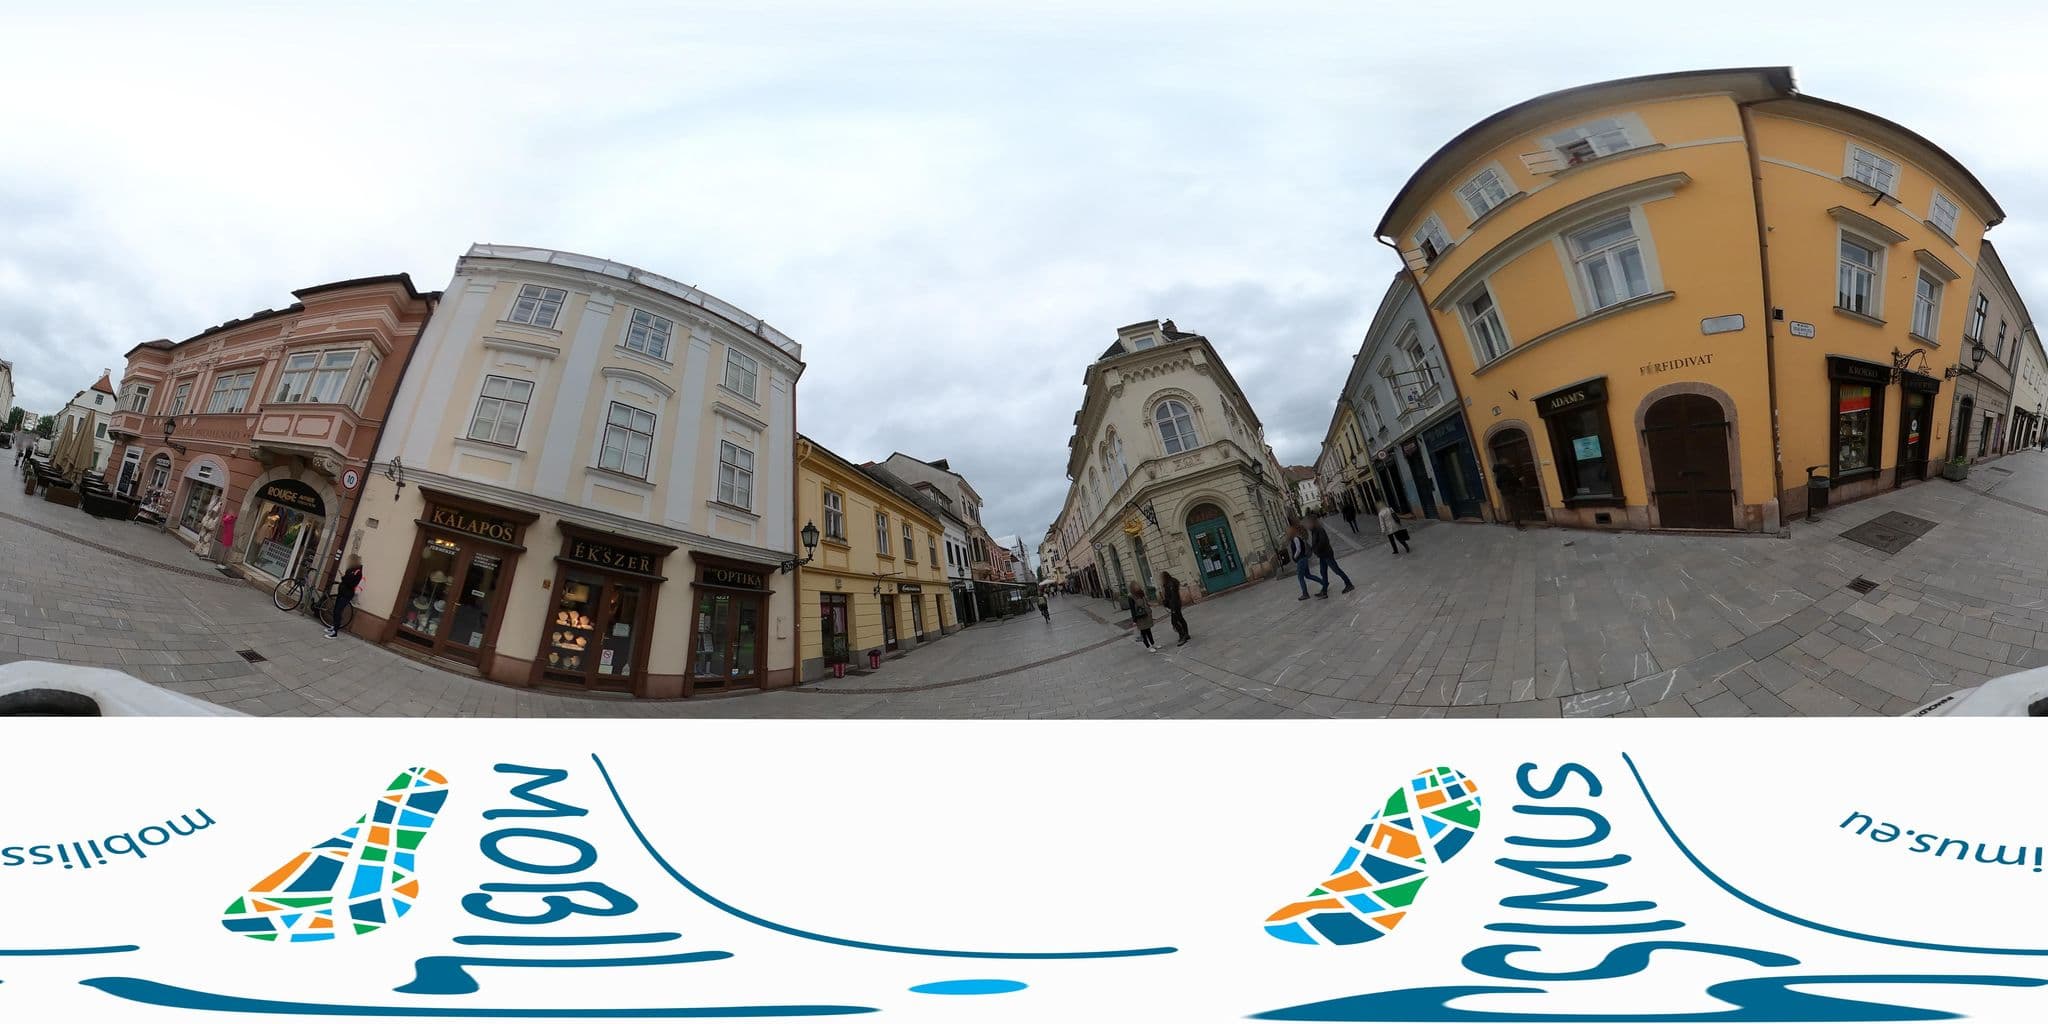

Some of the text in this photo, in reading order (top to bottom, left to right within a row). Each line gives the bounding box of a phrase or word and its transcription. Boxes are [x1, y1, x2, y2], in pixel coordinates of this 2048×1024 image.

[1639, 354, 1713, 376] FÉRFIDIVAT
[347, 475, 355, 484] 10
[267, 486, 298, 503] ROUGE
[433, 510, 513, 540] KALAPOS
[575, 542, 649, 571] ÉKSZER
[717, 569, 761, 585] OPTIKA
